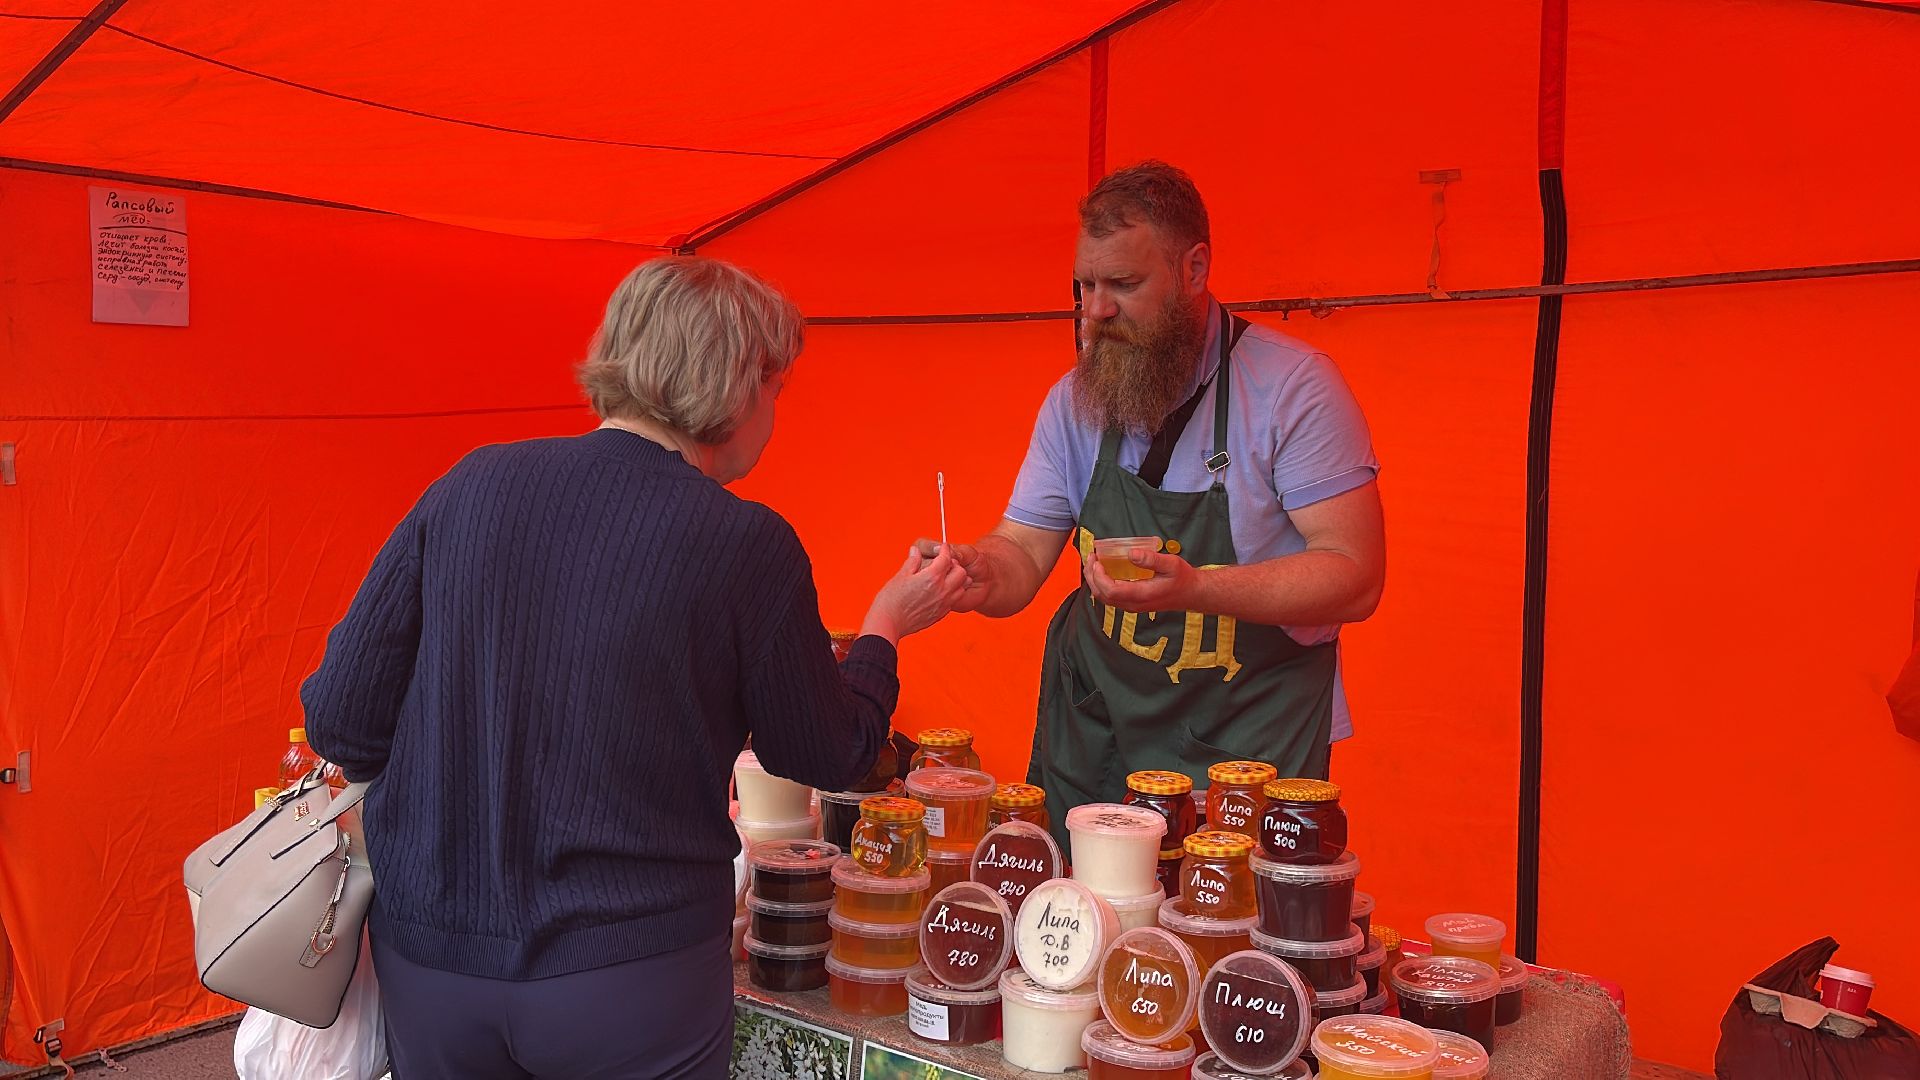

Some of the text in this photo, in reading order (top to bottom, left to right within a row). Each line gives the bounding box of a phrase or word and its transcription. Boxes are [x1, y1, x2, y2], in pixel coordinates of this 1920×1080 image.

[106, 191, 174, 214] Рапсовый
[1220, 797, 1252, 817] Липа
[1223, 814, 1246, 827] 550
[1265, 815, 1300, 836] Плющ
[855, 833, 892, 854] Акация
[1274, 833, 1296, 849] 500
[864, 851, 883, 863] 550
[978, 844, 1043, 873] Дягиль
[997, 880, 1025, 896] 840
[1191, 869, 1225, 893] Липа
[1196, 891, 1220, 904] 550
[928, 904, 996, 941] Дягиль
[1037, 902, 1080, 933] Липа
[948, 949, 978, 967] 780
[1043, 953, 1069, 966] 700
[1125, 958, 1173, 987] Липа
[1131, 997, 1158, 1015] 650
[1215, 982, 1285, 1019] Плющ
[1235, 1026, 1264, 1043] 610
[1332, 1023, 1429, 1058] Майский
[1336, 1040, 1375, 1055] 350
